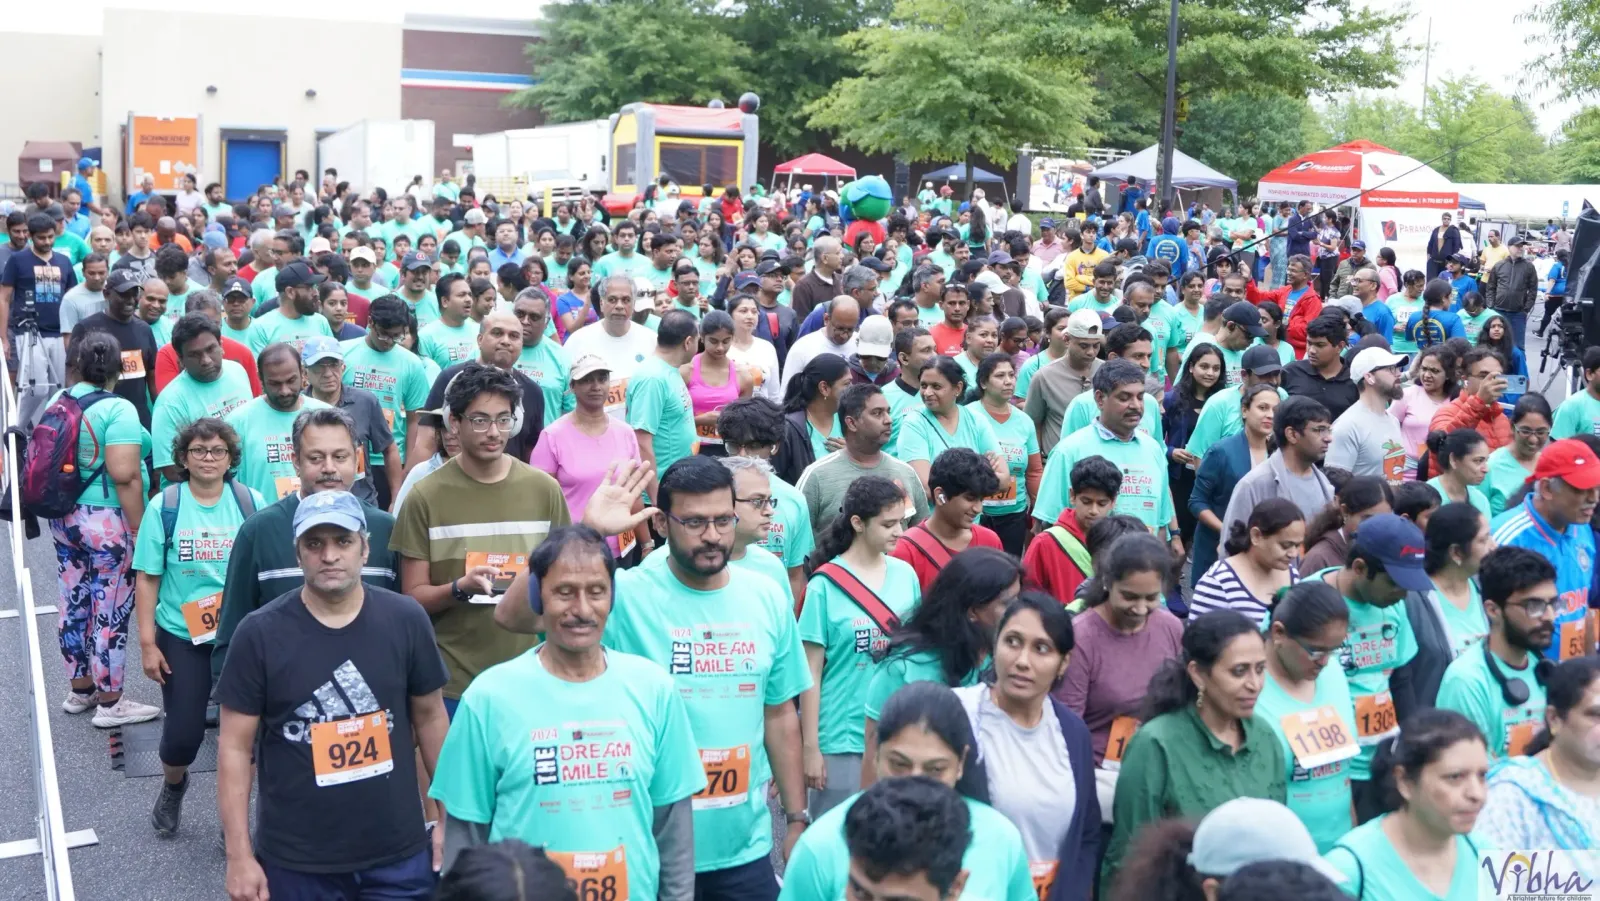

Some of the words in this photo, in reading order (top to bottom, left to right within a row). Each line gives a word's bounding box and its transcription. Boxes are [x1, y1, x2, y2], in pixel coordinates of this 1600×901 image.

[139, 134, 191, 142] SCHNEIDER
[1399, 224, 1433, 233] PARAMO
[121, 360, 138, 372] 69
[353, 372, 365, 388] THE
[365, 373, 396, 384] DREAM
[267, 444, 280, 463] THE
[179, 540, 194, 562] THE
[693, 641, 756, 656] DREAM
[855, 629, 871, 654] THE
[1354, 639, 1393, 654] DREAM
[670, 641, 692, 674] THE
[531, 728, 558, 741] 2024
[1295, 724, 1346, 753] 1198
[328, 736, 379, 769] 924
[560, 742, 631, 760] DREAM
[534, 746, 559, 785] THE
[694, 769, 737, 795] 70
